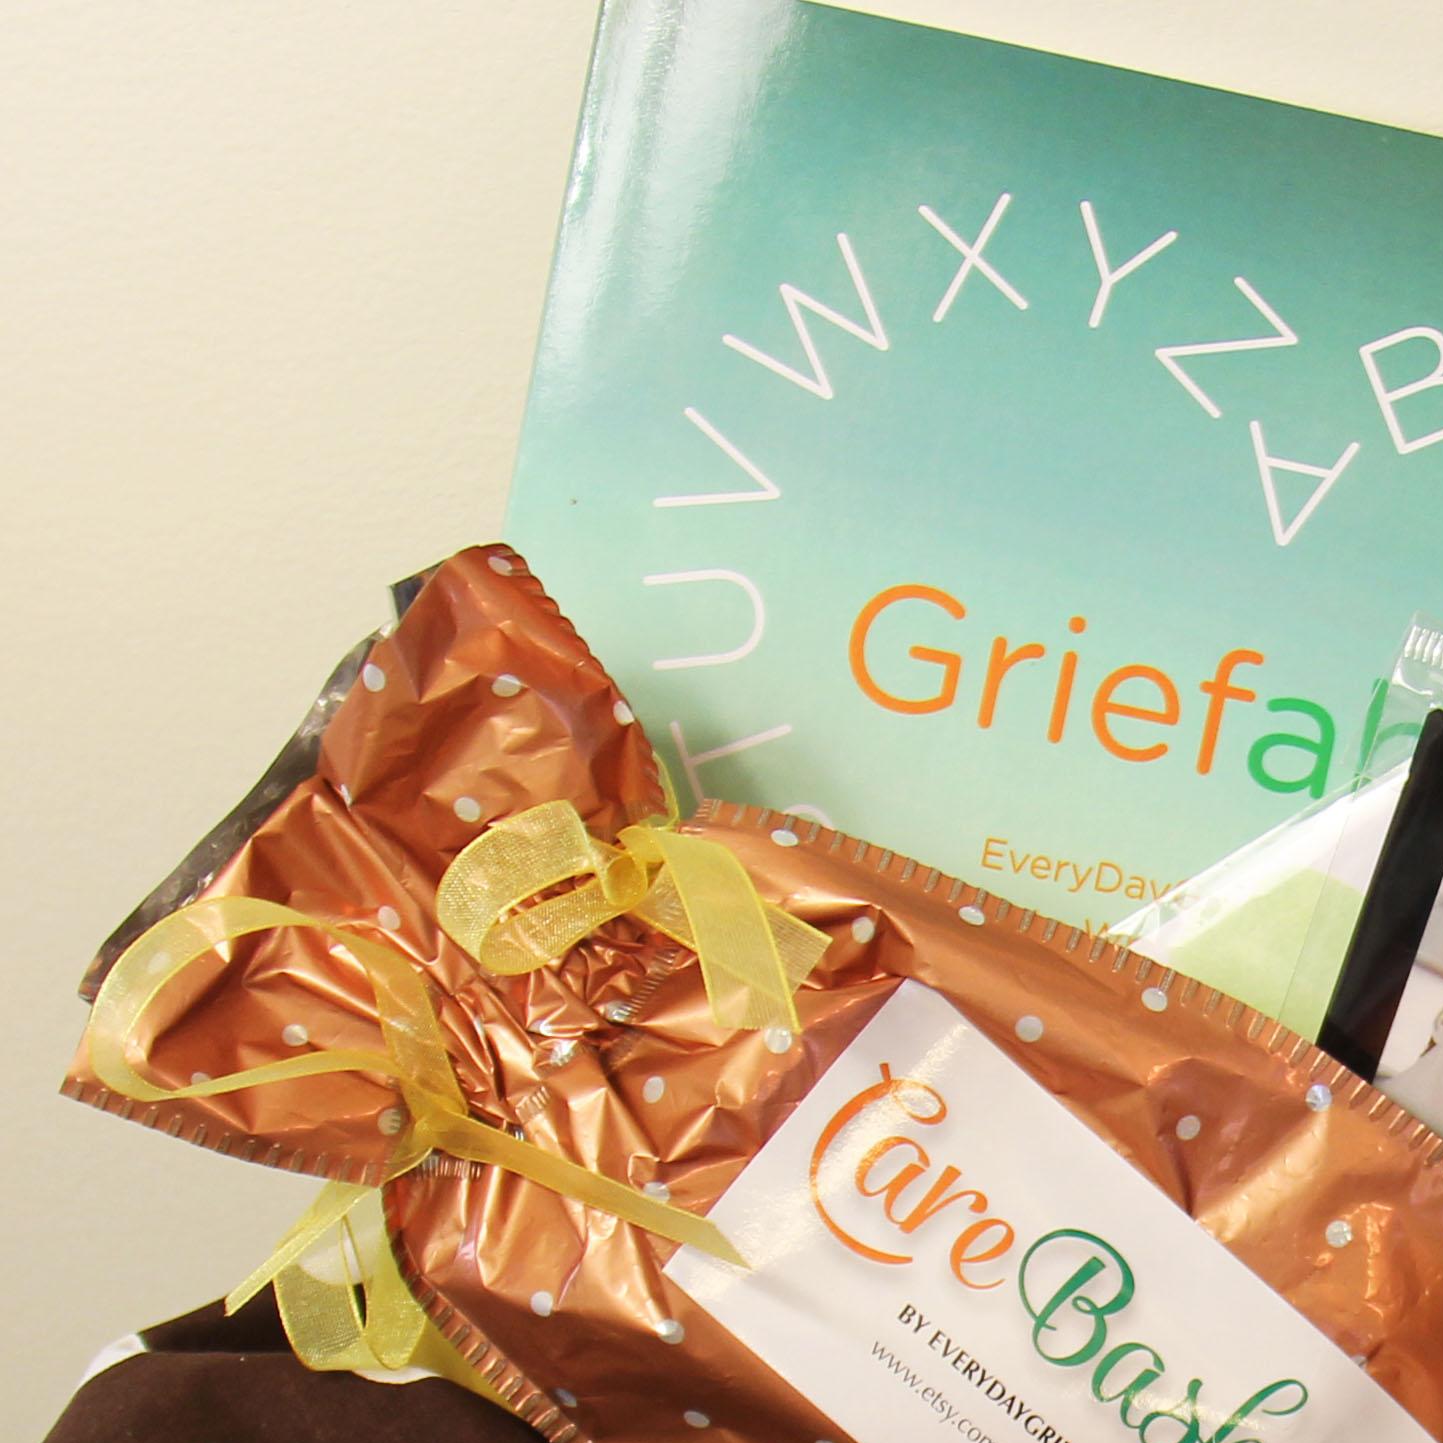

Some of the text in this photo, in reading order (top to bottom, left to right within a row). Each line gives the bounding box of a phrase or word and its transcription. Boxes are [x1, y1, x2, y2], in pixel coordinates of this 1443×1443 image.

[723, 233, 889, 399] W
[917, 193, 1028, 323] X
[1081, 201, 1178, 328] Y
[1155, 276, 1298, 418] Z
[653, 407, 780, 507] V
[1251, 420, 1359, 546] A
[643, 569, 764, 669] U
[809, 1062, 1015, 1290] Care
[897, 1304, 931, 1334] BY
